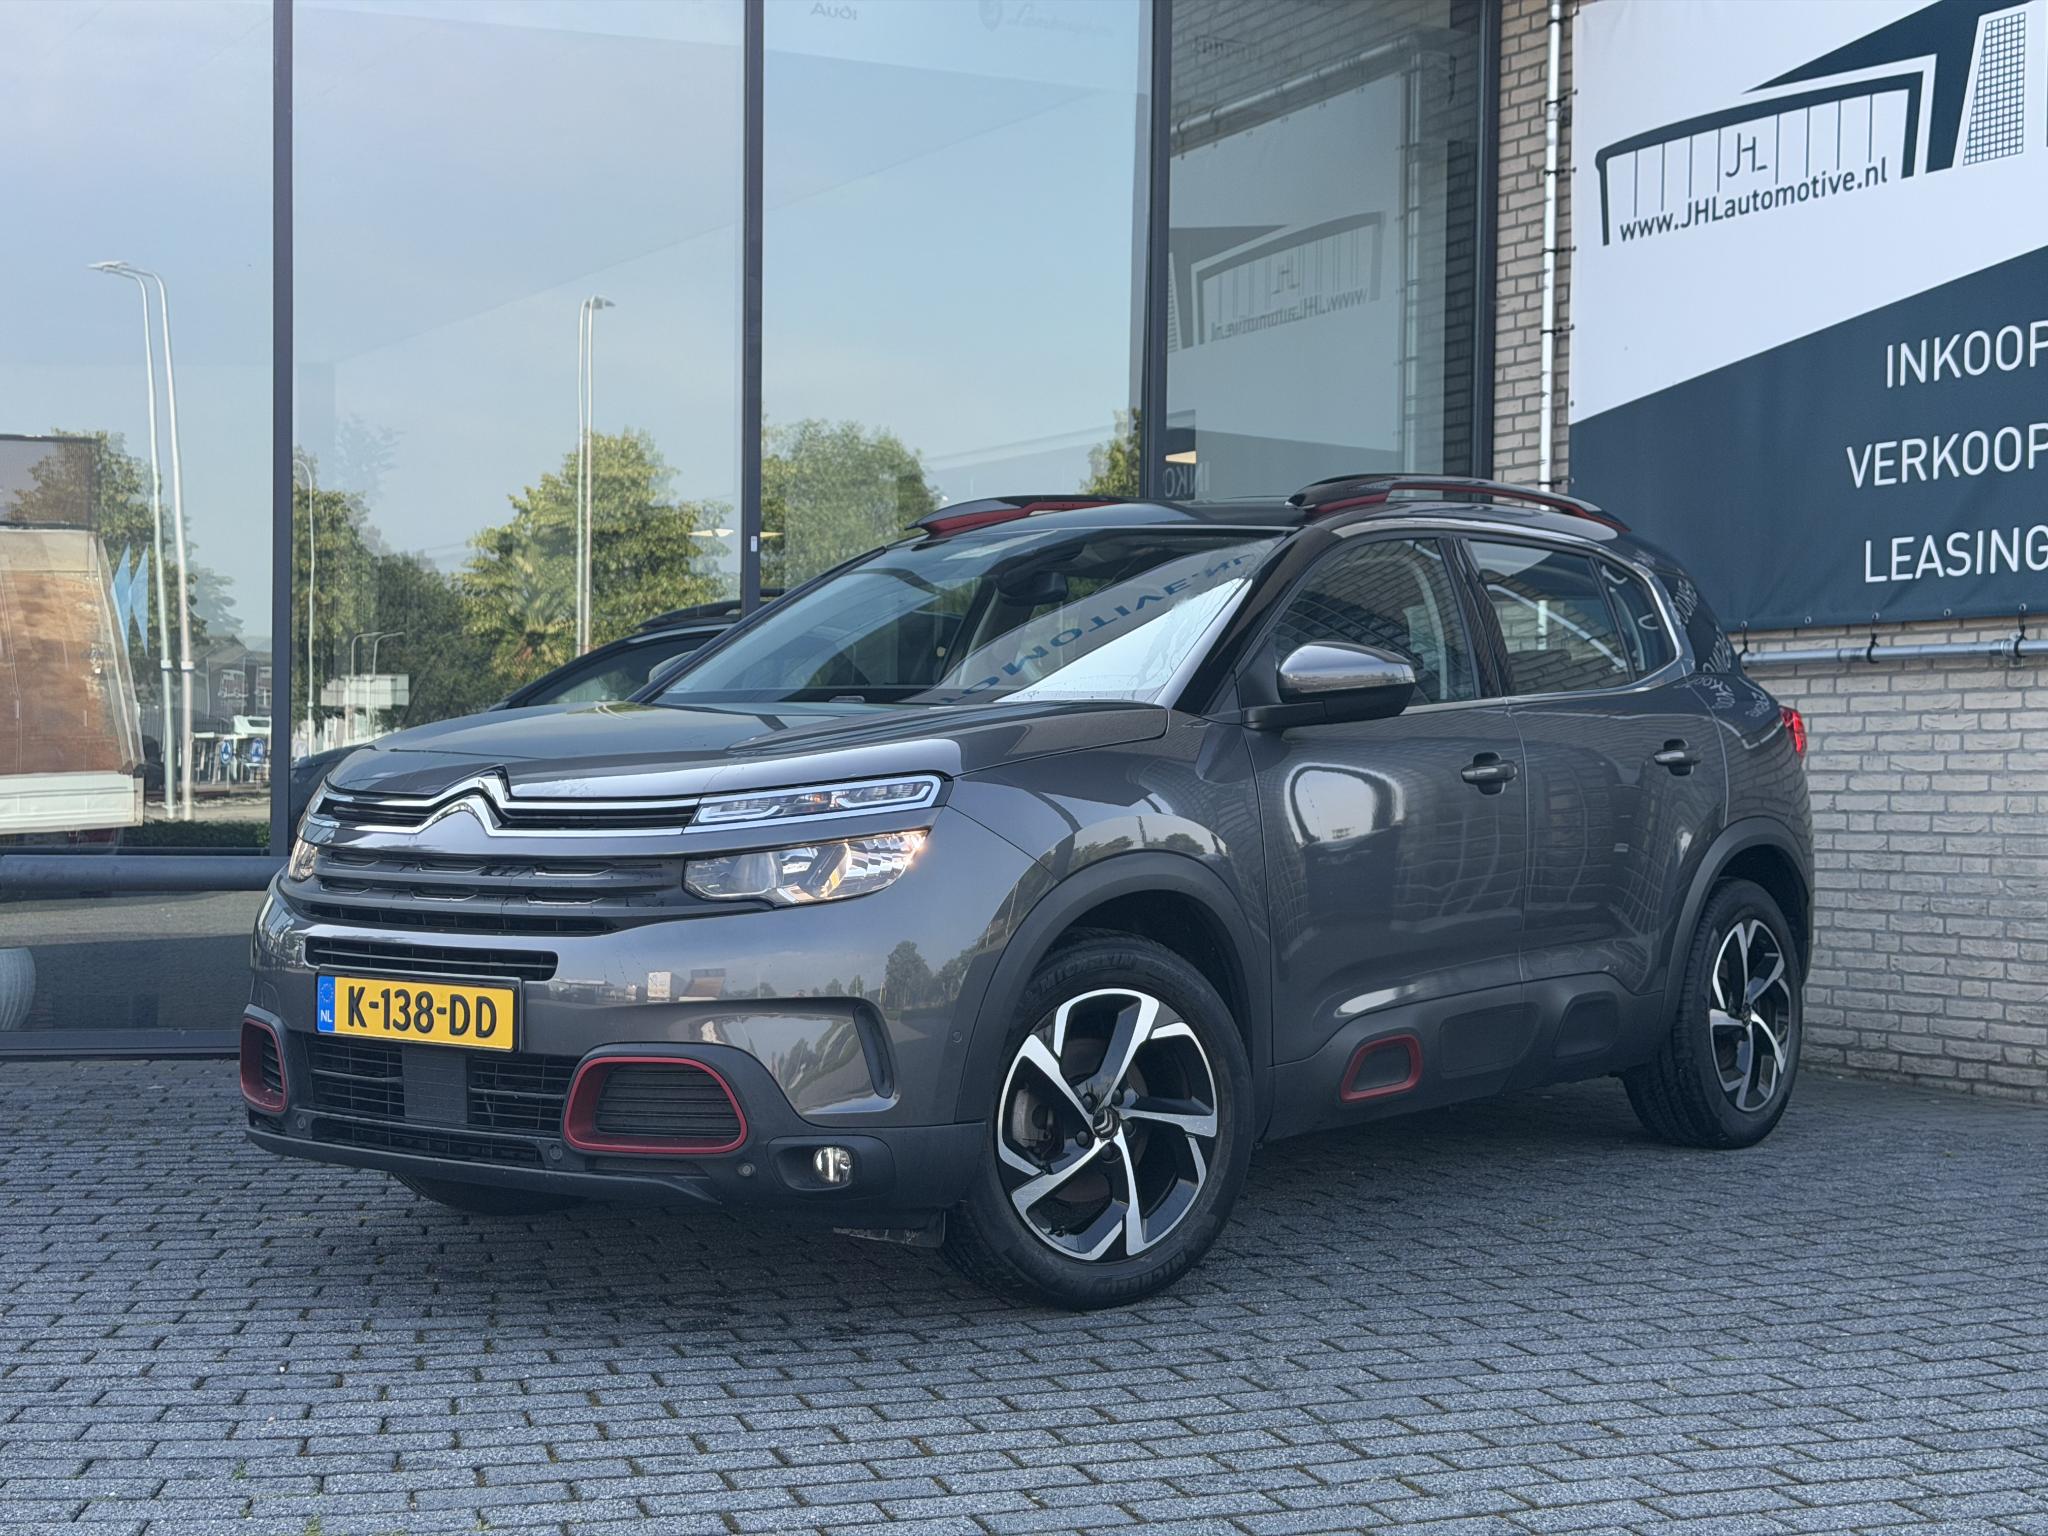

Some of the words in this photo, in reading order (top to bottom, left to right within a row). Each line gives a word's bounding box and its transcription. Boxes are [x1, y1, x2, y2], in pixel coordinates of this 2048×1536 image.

[1619, 156, 1888, 242] www.JHLautomotive.nl
[1886, 319, 2048, 388] INKOOP
[1846, 422, 2048, 489] VERKOOP
[1864, 524, 2048, 583] LEASING
[320, 1008, 333, 1023] NL
[347, 985, 498, 1039] K-138-DD
